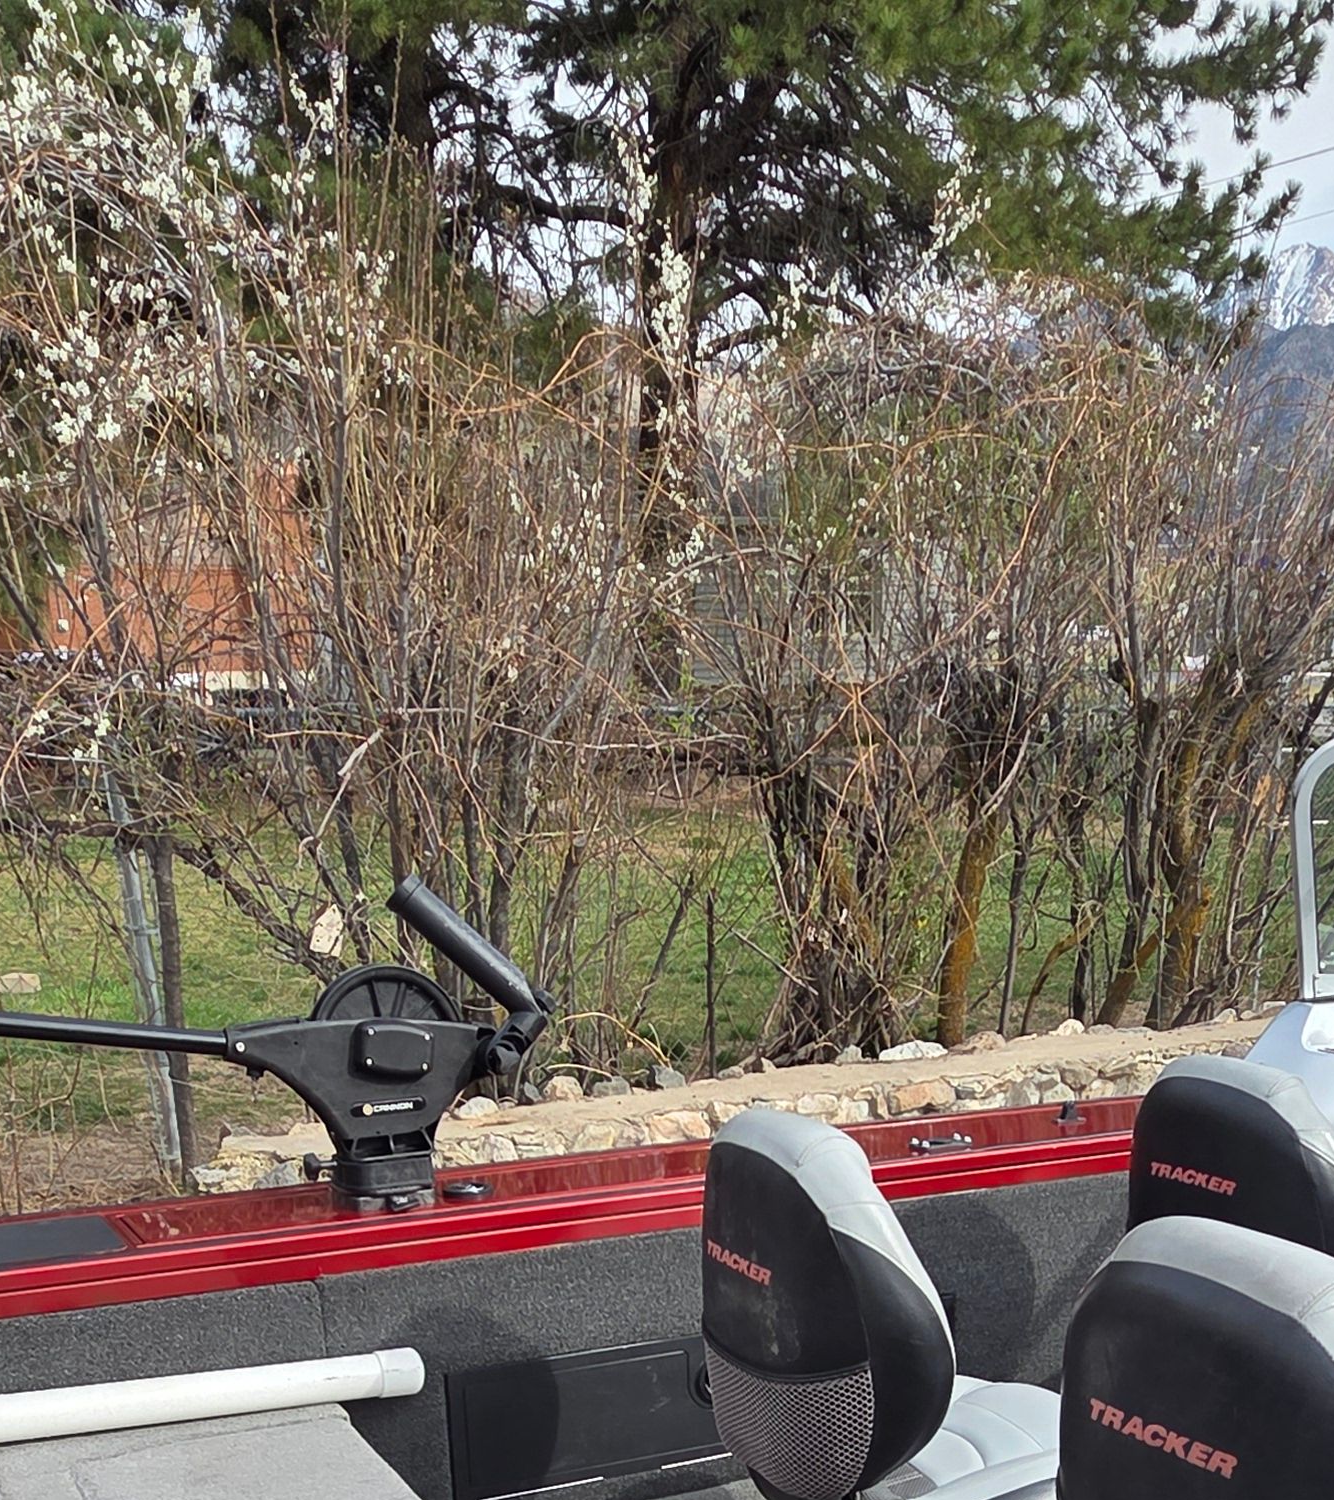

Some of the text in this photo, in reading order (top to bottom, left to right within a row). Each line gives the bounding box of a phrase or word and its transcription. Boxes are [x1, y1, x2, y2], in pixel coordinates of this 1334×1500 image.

[1150, 1161, 1237, 1196] TRACKER
[707, 1239, 772, 1286] TRACKER
[1090, 1397, 1238, 1479] TRACKER
